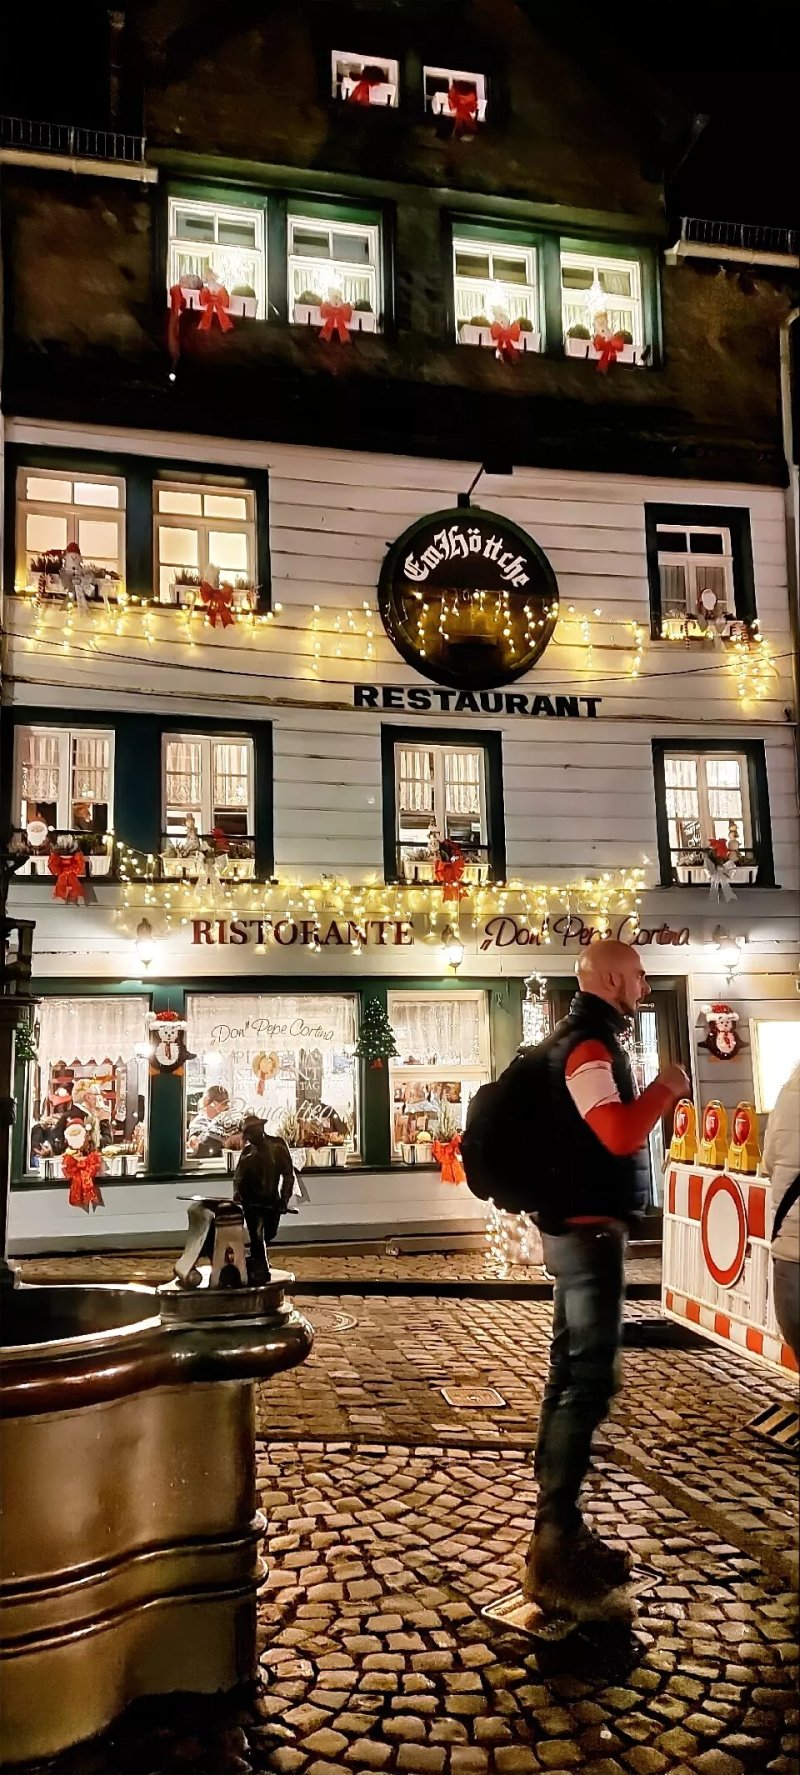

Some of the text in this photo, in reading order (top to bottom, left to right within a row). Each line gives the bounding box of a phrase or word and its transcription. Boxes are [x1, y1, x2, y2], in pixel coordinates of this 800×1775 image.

[353, 685, 602, 718] RESTAURANT
[190, 919, 414, 945] RISTORANTE
[617, 915, 690, 946] Cortina
[251, 1018, 287, 1038] Pepe
[290, 1018, 334, 1041] Cortina
